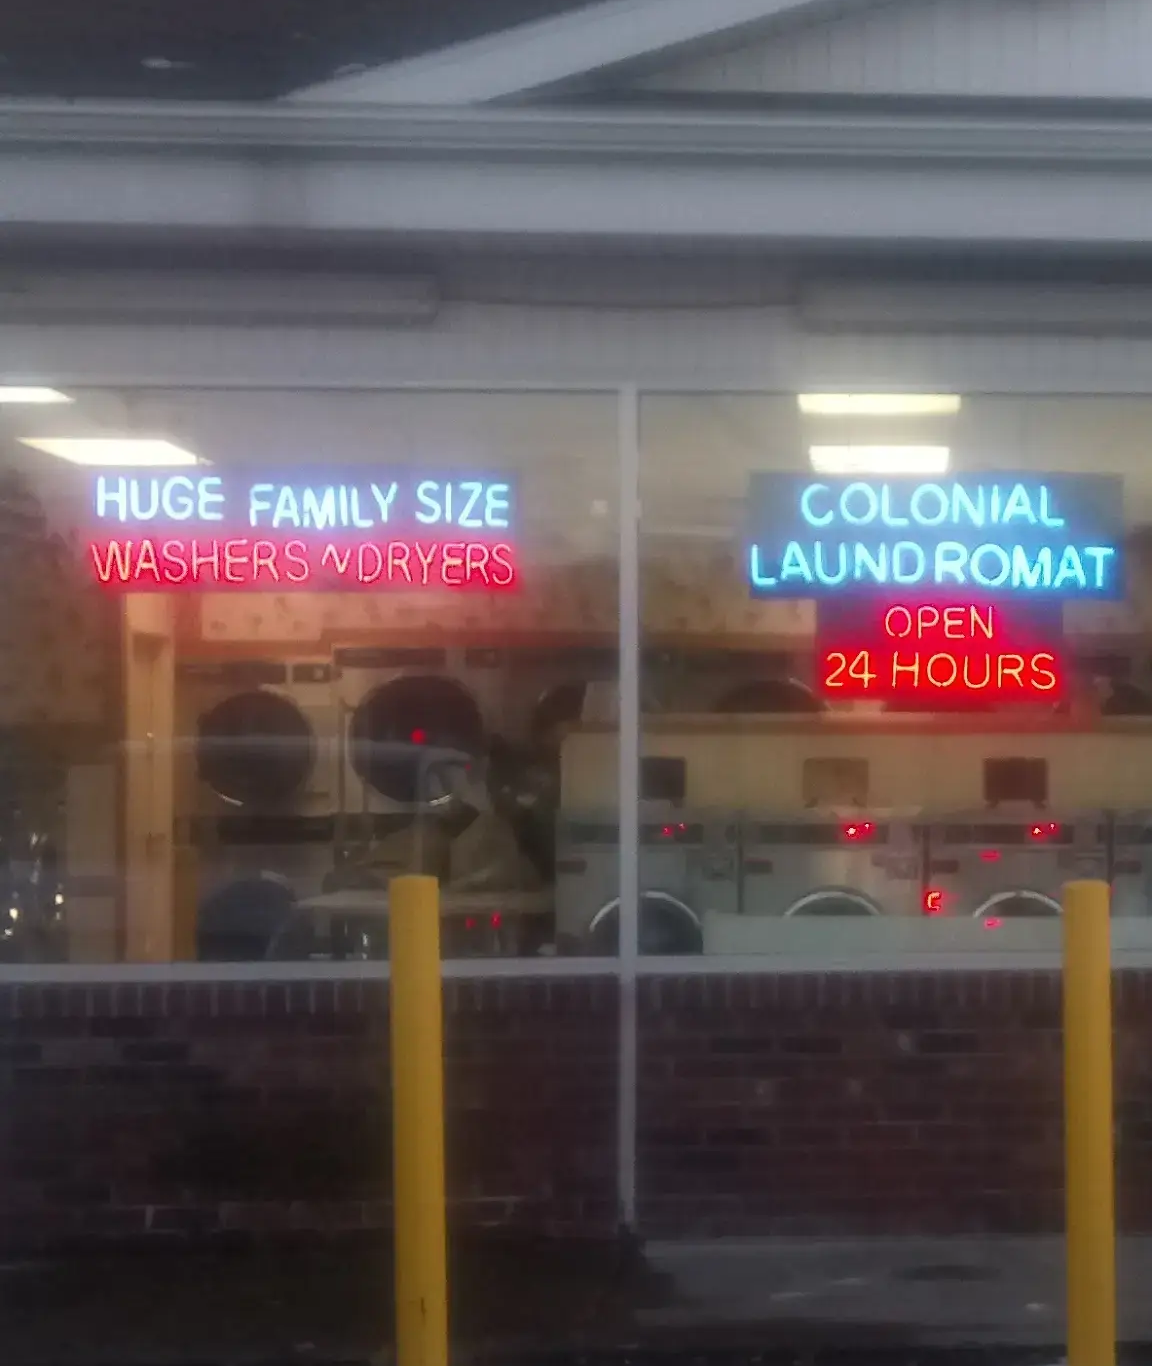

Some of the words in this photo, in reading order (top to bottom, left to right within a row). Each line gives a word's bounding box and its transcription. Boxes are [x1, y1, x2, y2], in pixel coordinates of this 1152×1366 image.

[95, 475, 225, 521] HUGE
[248, 482, 398, 530] FAMILY
[415, 480, 509, 528] SIZE
[801, 482, 1066, 527] COLONIAL
[92, 539, 310, 582] WASHERS
[357, 541, 514, 585] DRYERS
[751, 540, 1115, 588] LAUNDROMAT
[884, 605, 994, 639] OPEN
[825, 651, 877, 688] 24
[892, 652, 1056, 690] HOURS
